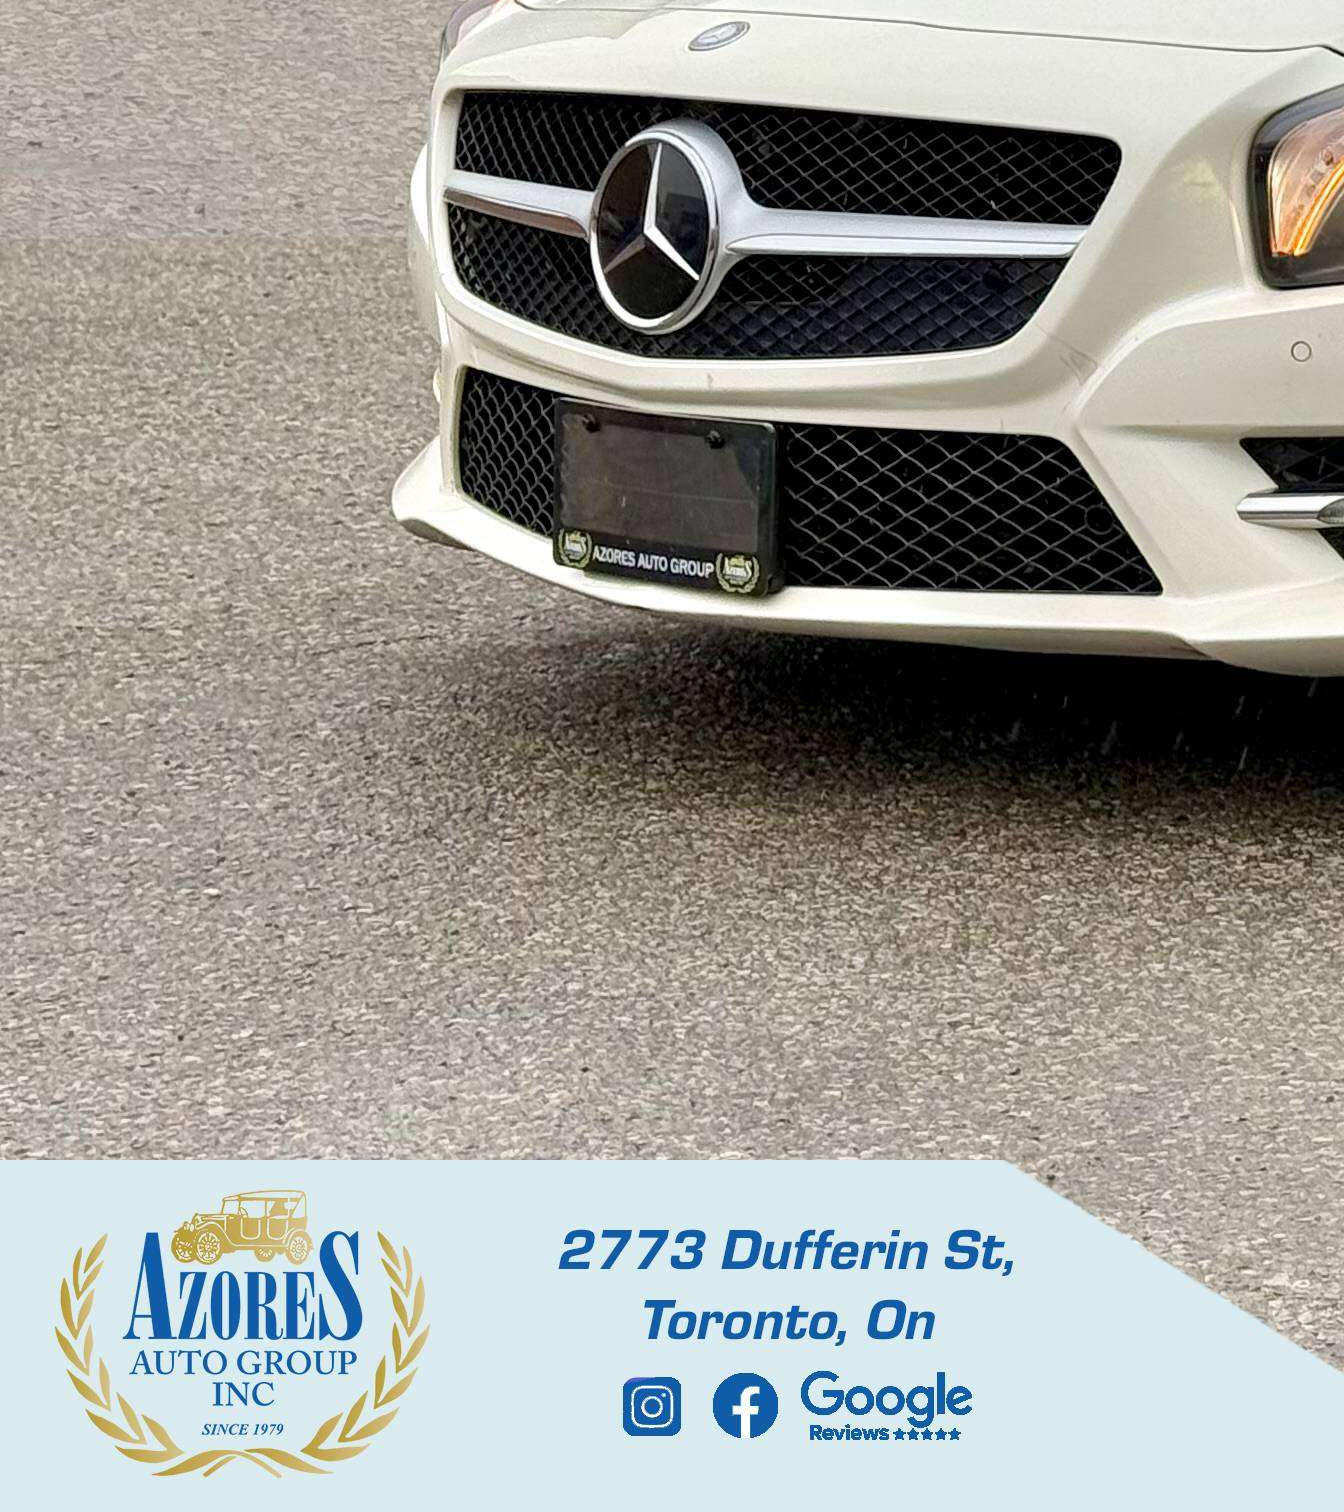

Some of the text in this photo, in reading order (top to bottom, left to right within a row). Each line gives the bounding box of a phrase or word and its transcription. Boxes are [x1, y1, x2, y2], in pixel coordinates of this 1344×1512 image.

[592, 545, 636, 567] AZORES
[637, 552, 668, 572] AUTO
[670, 557, 715, 579] GROUP
